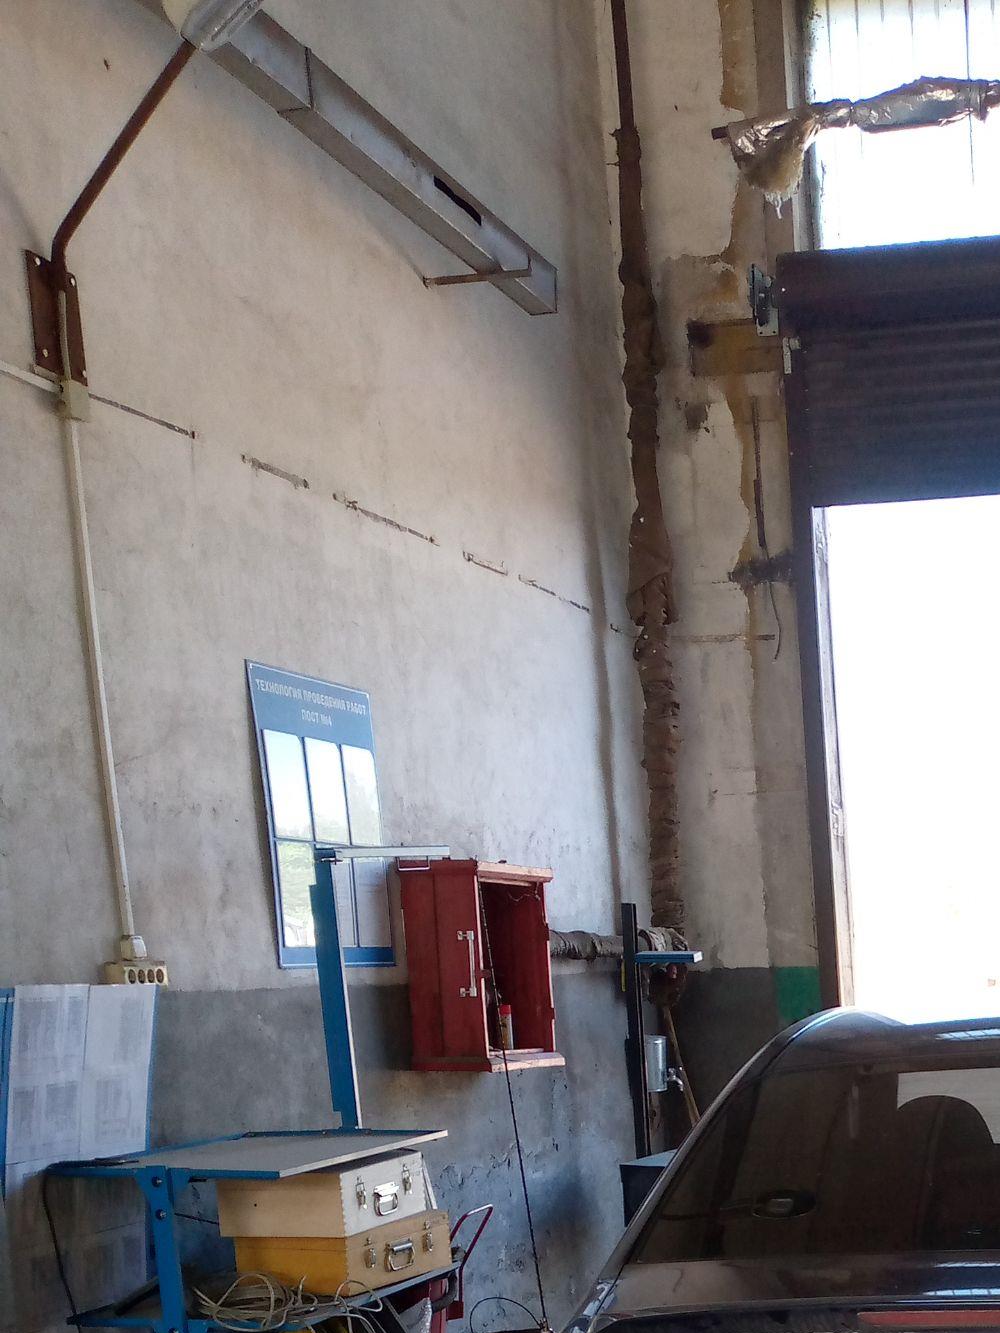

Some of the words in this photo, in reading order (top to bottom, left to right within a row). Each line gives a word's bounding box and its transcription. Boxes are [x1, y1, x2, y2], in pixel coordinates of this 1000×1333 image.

[255, 678, 303, 700] ТЕХНОЛОГИЯ
[345, 701, 366, 716] РАБОТ
[301, 709, 320, 724] ПОСТ
